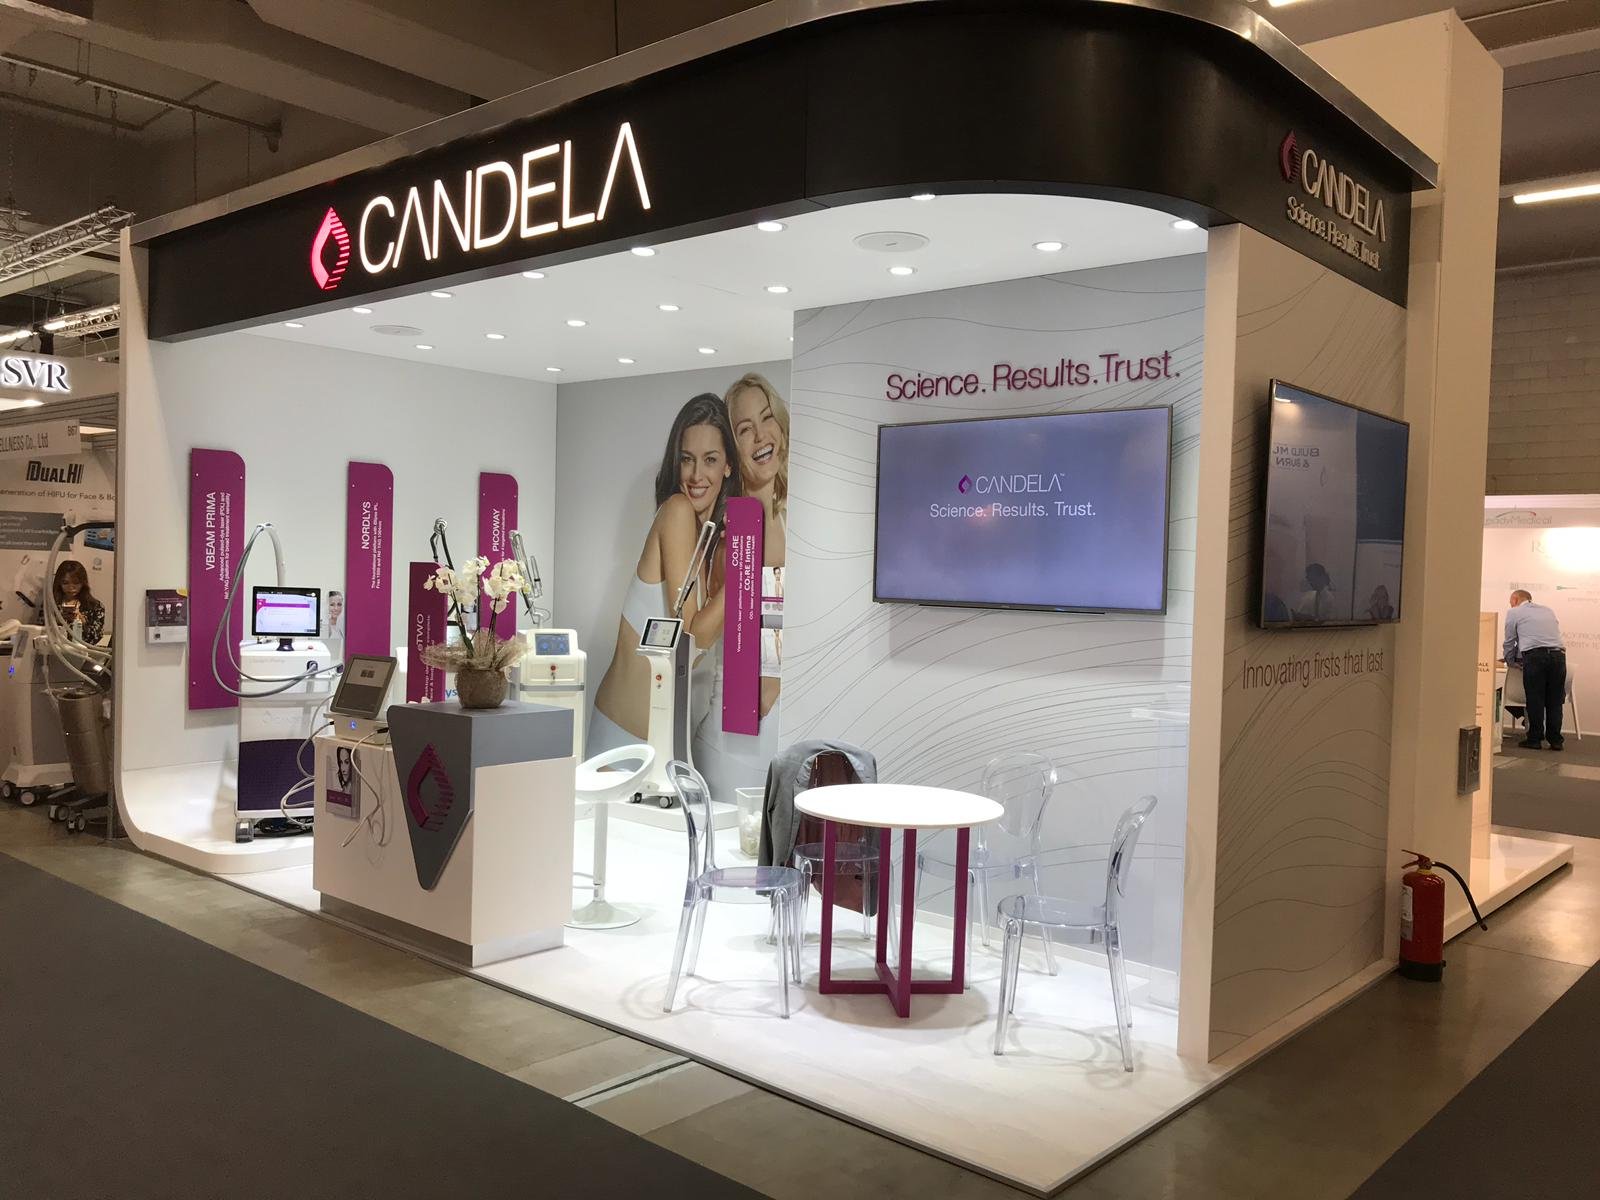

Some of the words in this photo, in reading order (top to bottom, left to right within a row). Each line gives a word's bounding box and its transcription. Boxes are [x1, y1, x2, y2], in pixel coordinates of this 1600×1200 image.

[359, 121, 651, 274] CANDELA
[1301, 149, 1386, 242] CANDELA
[3, 357, 71, 391] SVR
[886, 373, 986, 401] Science.
[993, 358, 1099, 392] Results.
[1099, 350, 1181, 383] Trust.
[66, 490, 78, 499] for
[79, 492, 97, 500] Face
[206, 491, 216, 528] PRIMA
[929, 503, 987, 518] Science.
[992, 502, 1049, 517] Results.
[1054, 501, 1096, 516] Trust.
[361, 501, 371, 549] NORDLYS
[492, 508, 500, 552] PICOWAY
[206, 531, 216, 571] VBEAM
[1242, 654, 1310, 689] Innovating
[1314, 652, 1340, 680] firsts
[1344, 648, 1364, 675] that
[1367, 647, 1384, 672] last
